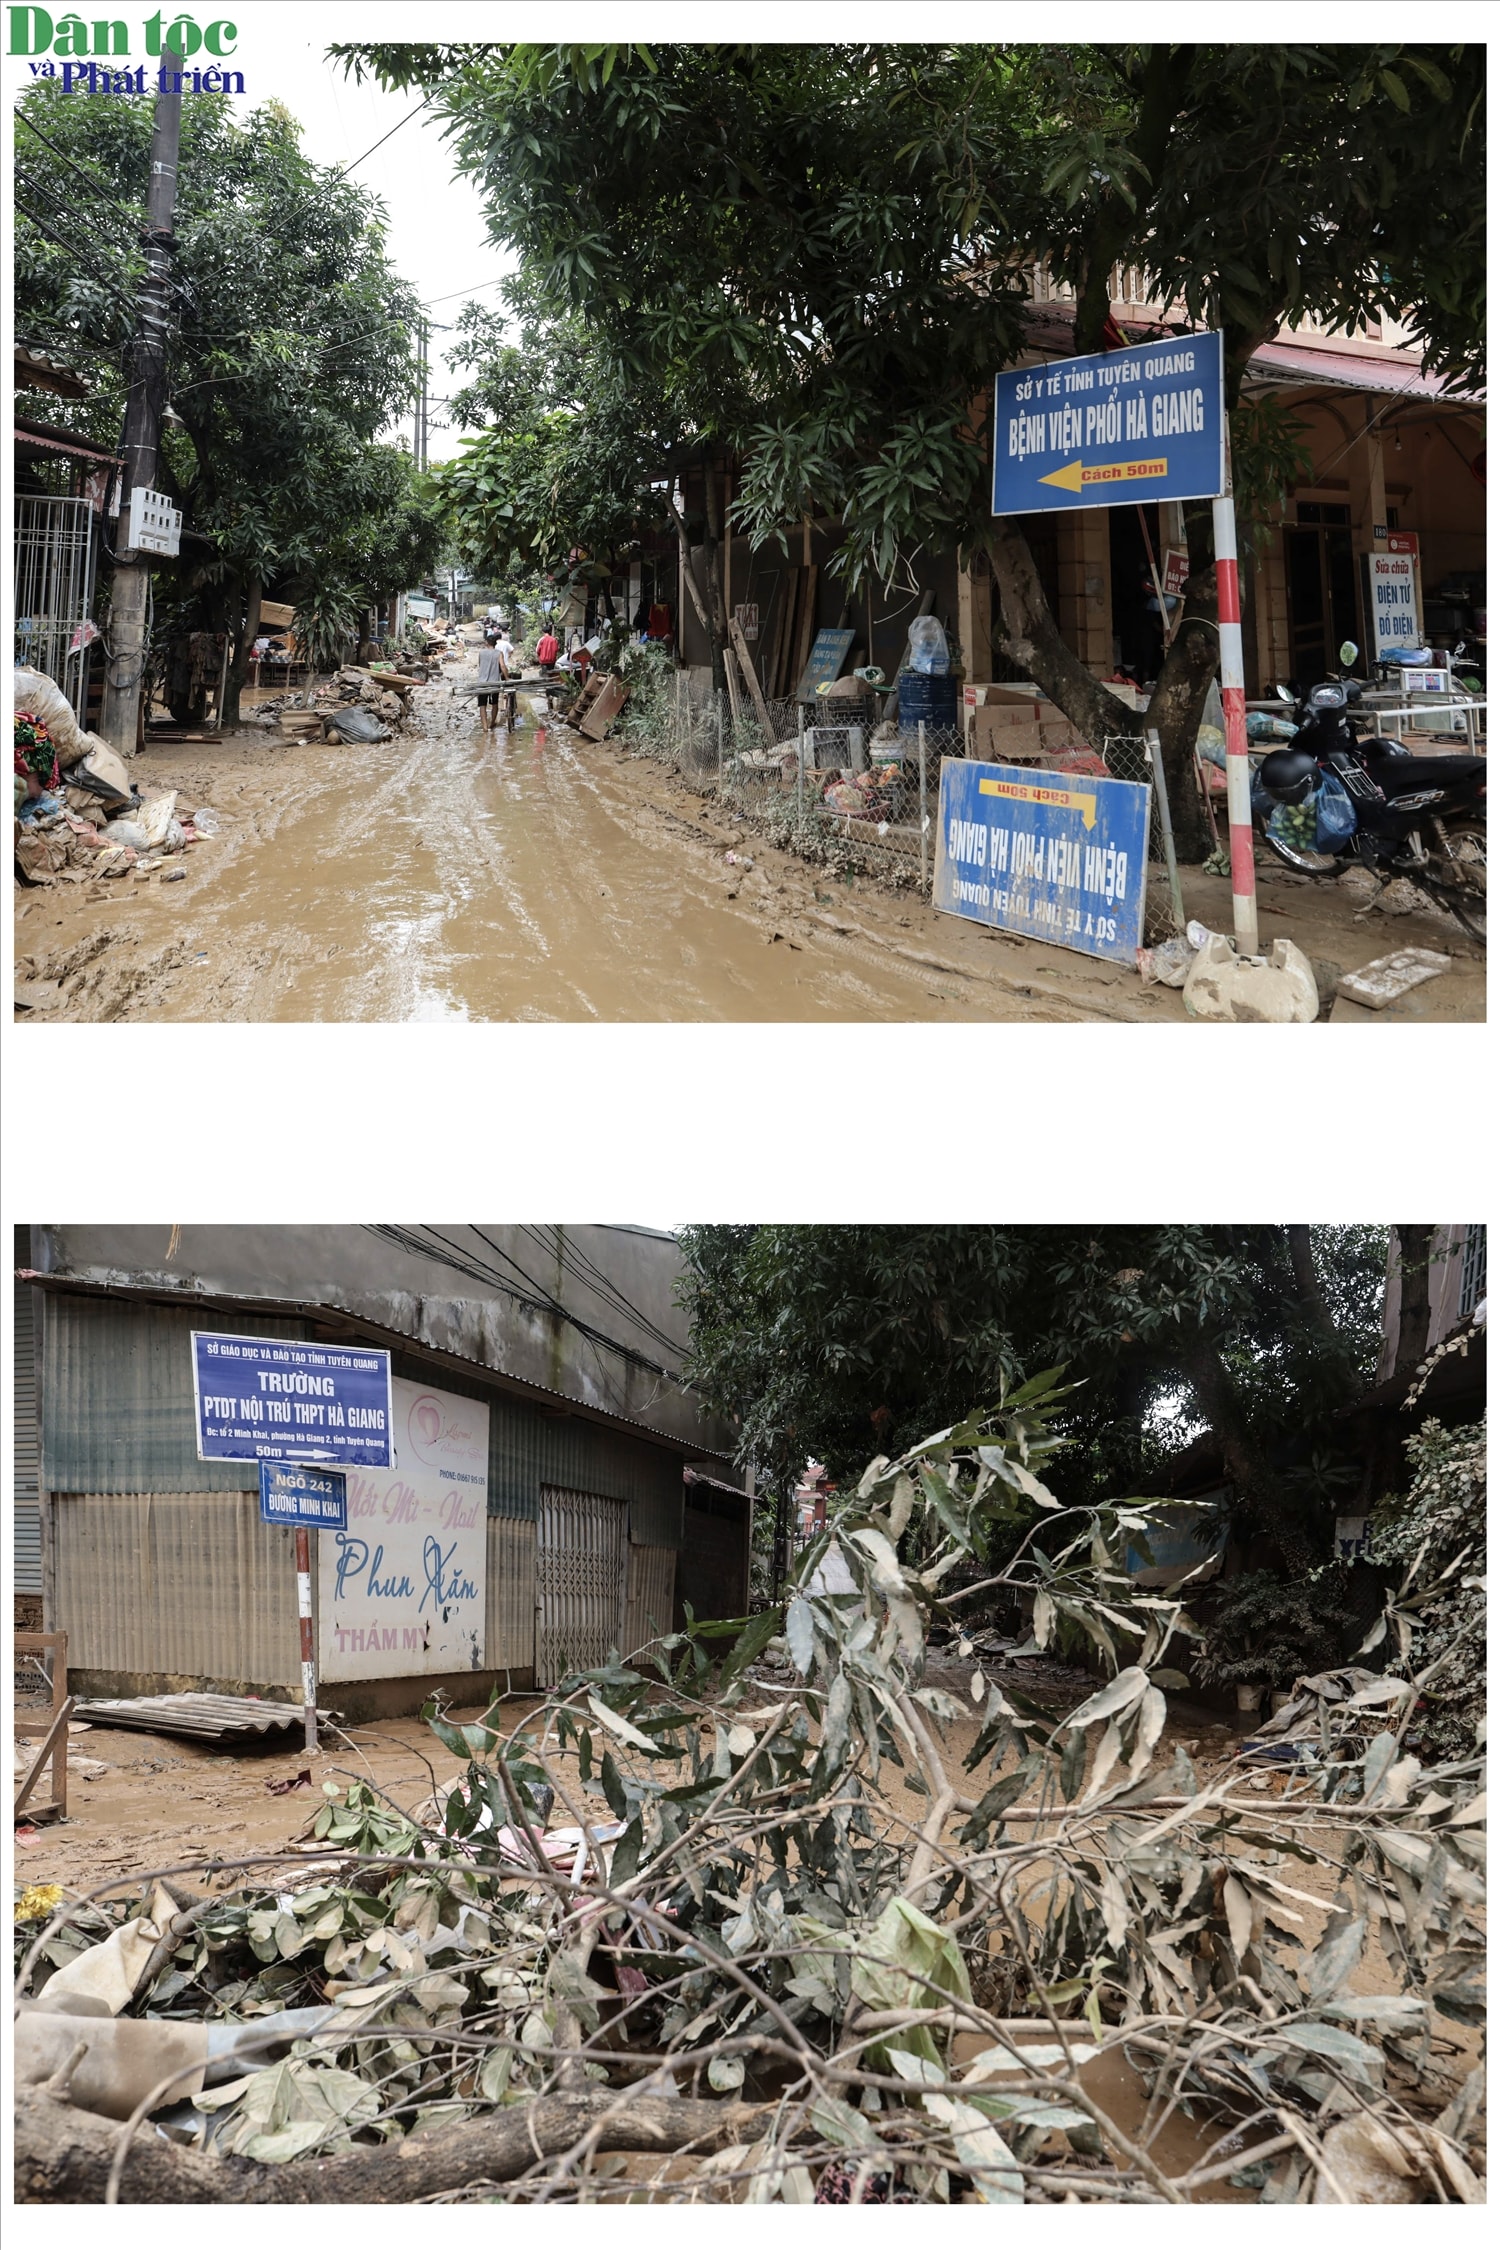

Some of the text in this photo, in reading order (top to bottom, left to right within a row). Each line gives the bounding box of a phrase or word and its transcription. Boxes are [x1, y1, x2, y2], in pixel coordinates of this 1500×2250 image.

[1016, 352, 1195, 401] SỞ Y TẾ TỈNH TUYÊN QUANG
[1009, 387, 1204, 462] BỆNH VIỆN PHỔI HÀ GIANG
[1081, 463, 1164, 482] Cách 50m
[1375, 559, 1409, 574] Sửa chữa
[1377, 577, 1411, 608] ĐIỆN TỬ
[1393, 612, 1413, 639] ĐIỆN
[997, 784, 1070, 805] Cách 50m
[949, 819, 1128, 906] BỆNH VIỆN PHỔI HÀ GIANG
[952, 878, 1116, 947] SỞ Y TẾ TỈNH TUYÊN QUANG
[206, 1341, 378, 1370] SỞ GIÁO DỤC VÀ ĐÀO TẠO TỈNH TUYÊN QUANG
[257, 1371, 335, 1397] TRƯỜNG
[204, 1396, 385, 1430] PTDT NỘI TRÚ THPT HÀ GIANG
[228, 1429, 233, 1438] 2
[234, 1429, 252, 1438] Minh
[252, 1430, 270, 1440] Khai,
[271, 1432, 295, 1442] phường
[296, 1432, 305, 1442] Hà
[306, 1433, 325, 1444] Giang
[326, 1435, 333, 1445] 2,
[333, 1434, 346, 1445] tỉnh
[346, 1436, 365, 1447] Tuyên
[365, 1438, 385, 1448] Quang
[255, 1445, 282, 1457] 50m
[276, 1474, 333, 1494] NGÕ 242
[440, 1469, 457, 1481] PHONE:
[269, 1491, 340, 1518] ĐƯỜNG MINH KHAI
[346, 1473, 378, 1518] Nối
[439, 1490, 480, 1530] Nail
[335, 1532, 478, 1613] Phun Xăm
[335, 1619, 398, 1652] THẨM
